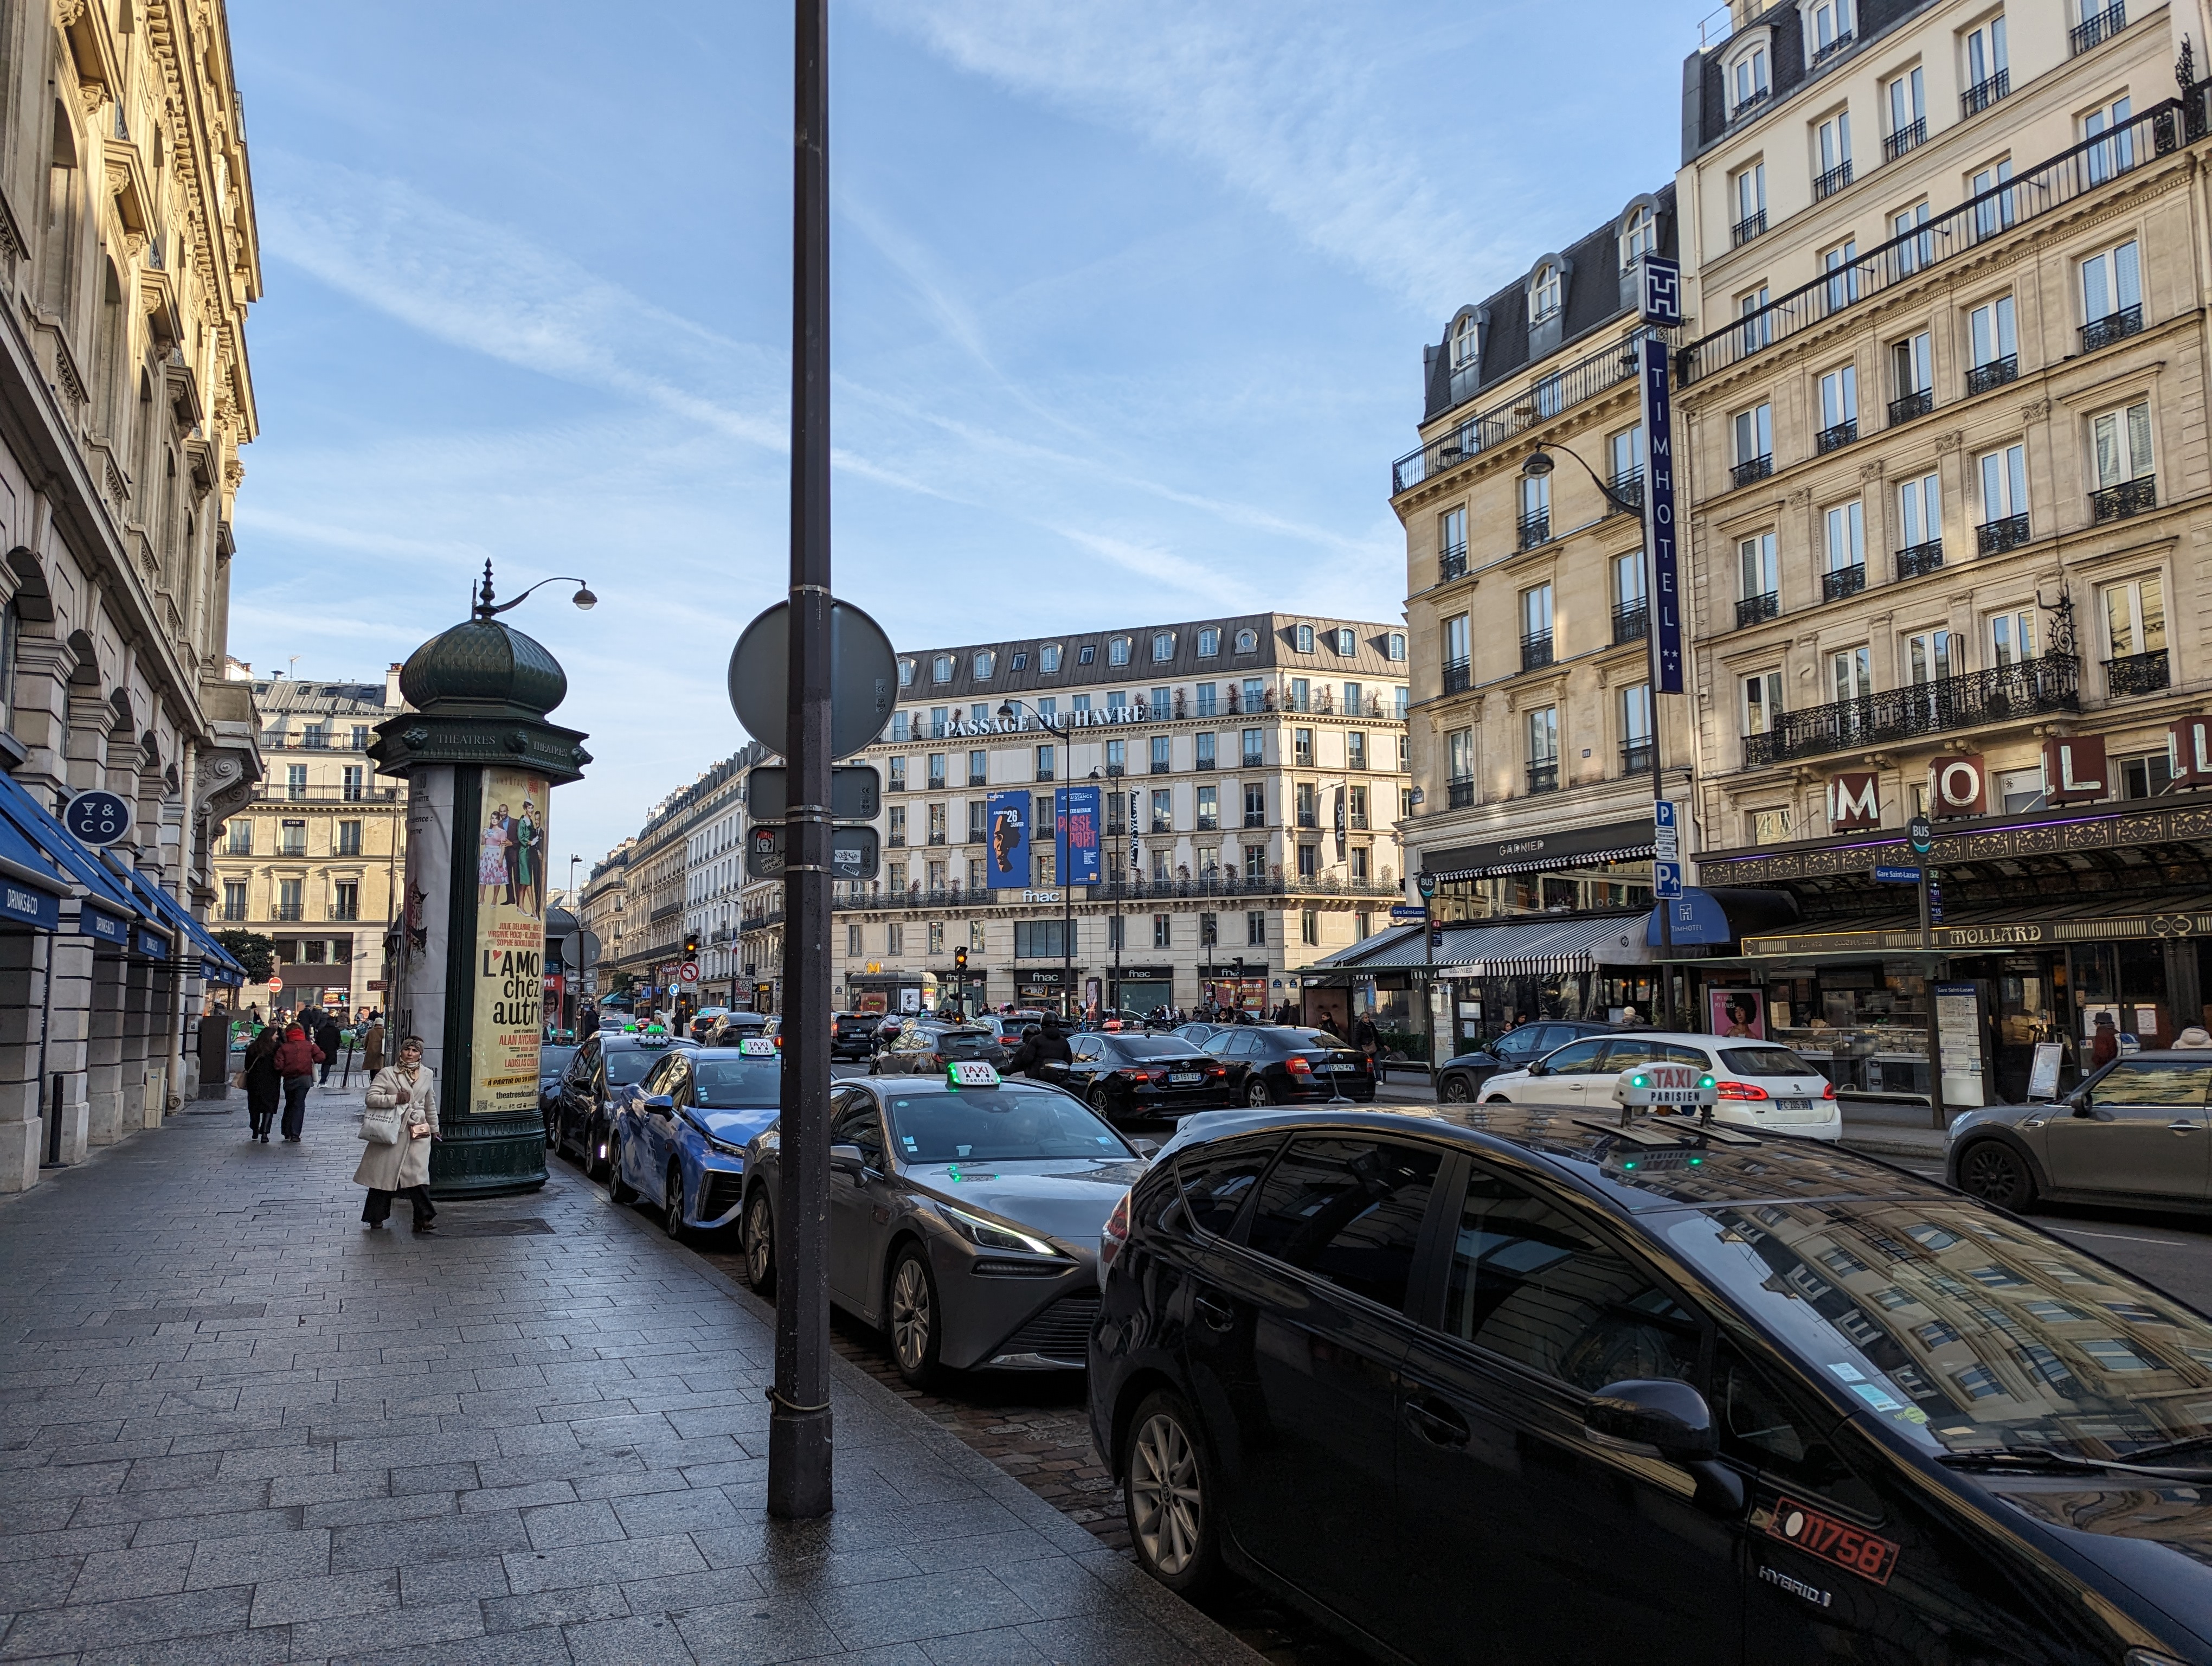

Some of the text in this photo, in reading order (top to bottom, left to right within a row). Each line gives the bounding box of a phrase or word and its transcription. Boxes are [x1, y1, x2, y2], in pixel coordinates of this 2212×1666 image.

[943, 705, 1144, 738] PASSAGE DU HAVRE
[437, 733, 496, 745] THEATRES
[532, 740, 568, 758] THEATRES
[1007, 810, 1017, 822] 26
[1661, 806, 1669, 822] P
[1913, 825, 1929, 837] BUS
[1499, 841, 1544, 856] GARNIER
[771, 859, 784, 869] SHIT
[1657, 865, 1670, 889] P
[1877, 870, 1920, 879] Gare Saint-Lazare
[7, 889, 37, 915] DRINKS&CO
[1023, 890, 1060, 902] fnac
[1950, 926, 2041, 944] MOLLARD
[1032, 972, 1059, 982] fnac
[1128, 970, 1151, 978] fnac
[499, 1034, 516, 1046] ALAN
[1654, 1069, 1691, 1087] TAXI
[1651, 1092, 1700, 1101] PARISIEN
[1780, 1100, 1809, 1110] FC-205-BB
[1801, 1514, 1885, 1573] 11758
